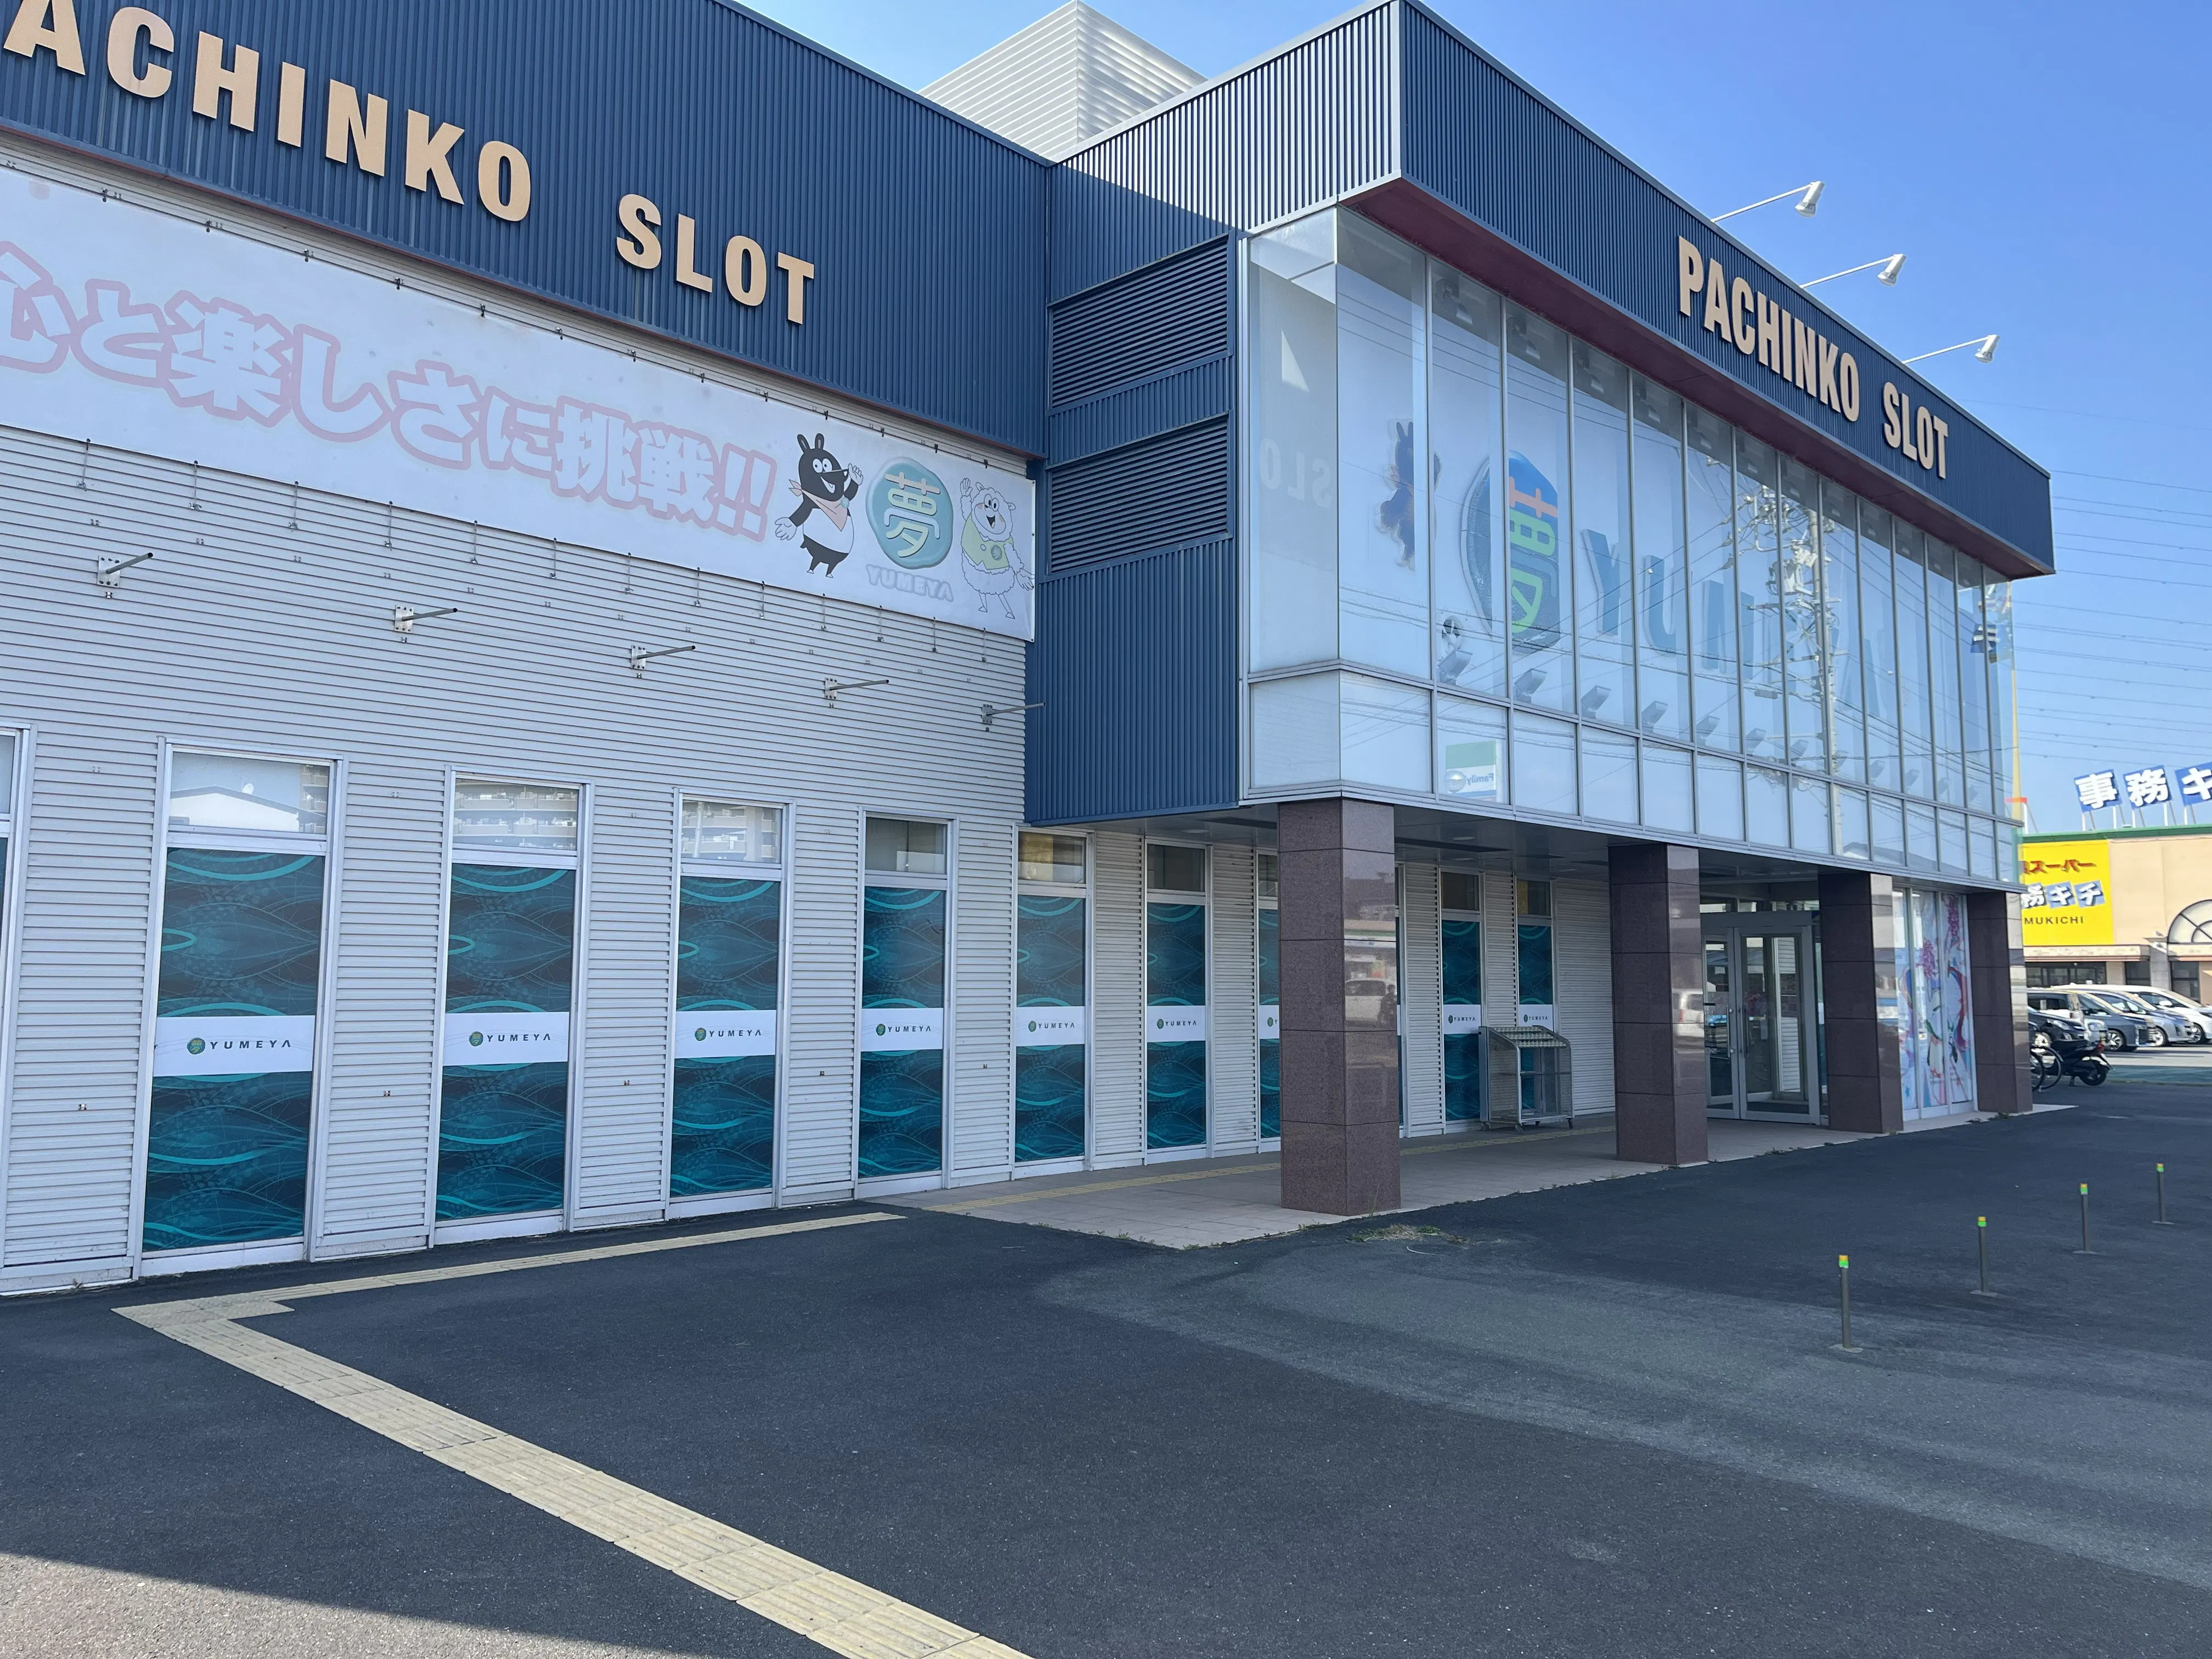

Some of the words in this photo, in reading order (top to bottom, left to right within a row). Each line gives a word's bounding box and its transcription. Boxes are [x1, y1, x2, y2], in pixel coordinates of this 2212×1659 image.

[616, 193, 815, 325] SLOT
[1679, 235, 1860, 422] PACHINKO
[1883, 381, 1948, 479] SLOT
[884, 471, 940, 557] 夢
[866, 564, 953, 602] YUMEYA
[2024, 916, 2084, 925] MUKICHI
[210, 1040, 291, 1049] YUMEYA
[487, 1034, 551, 1042] YUMEYA
[709, 1029, 761, 1037] YUMEYA
